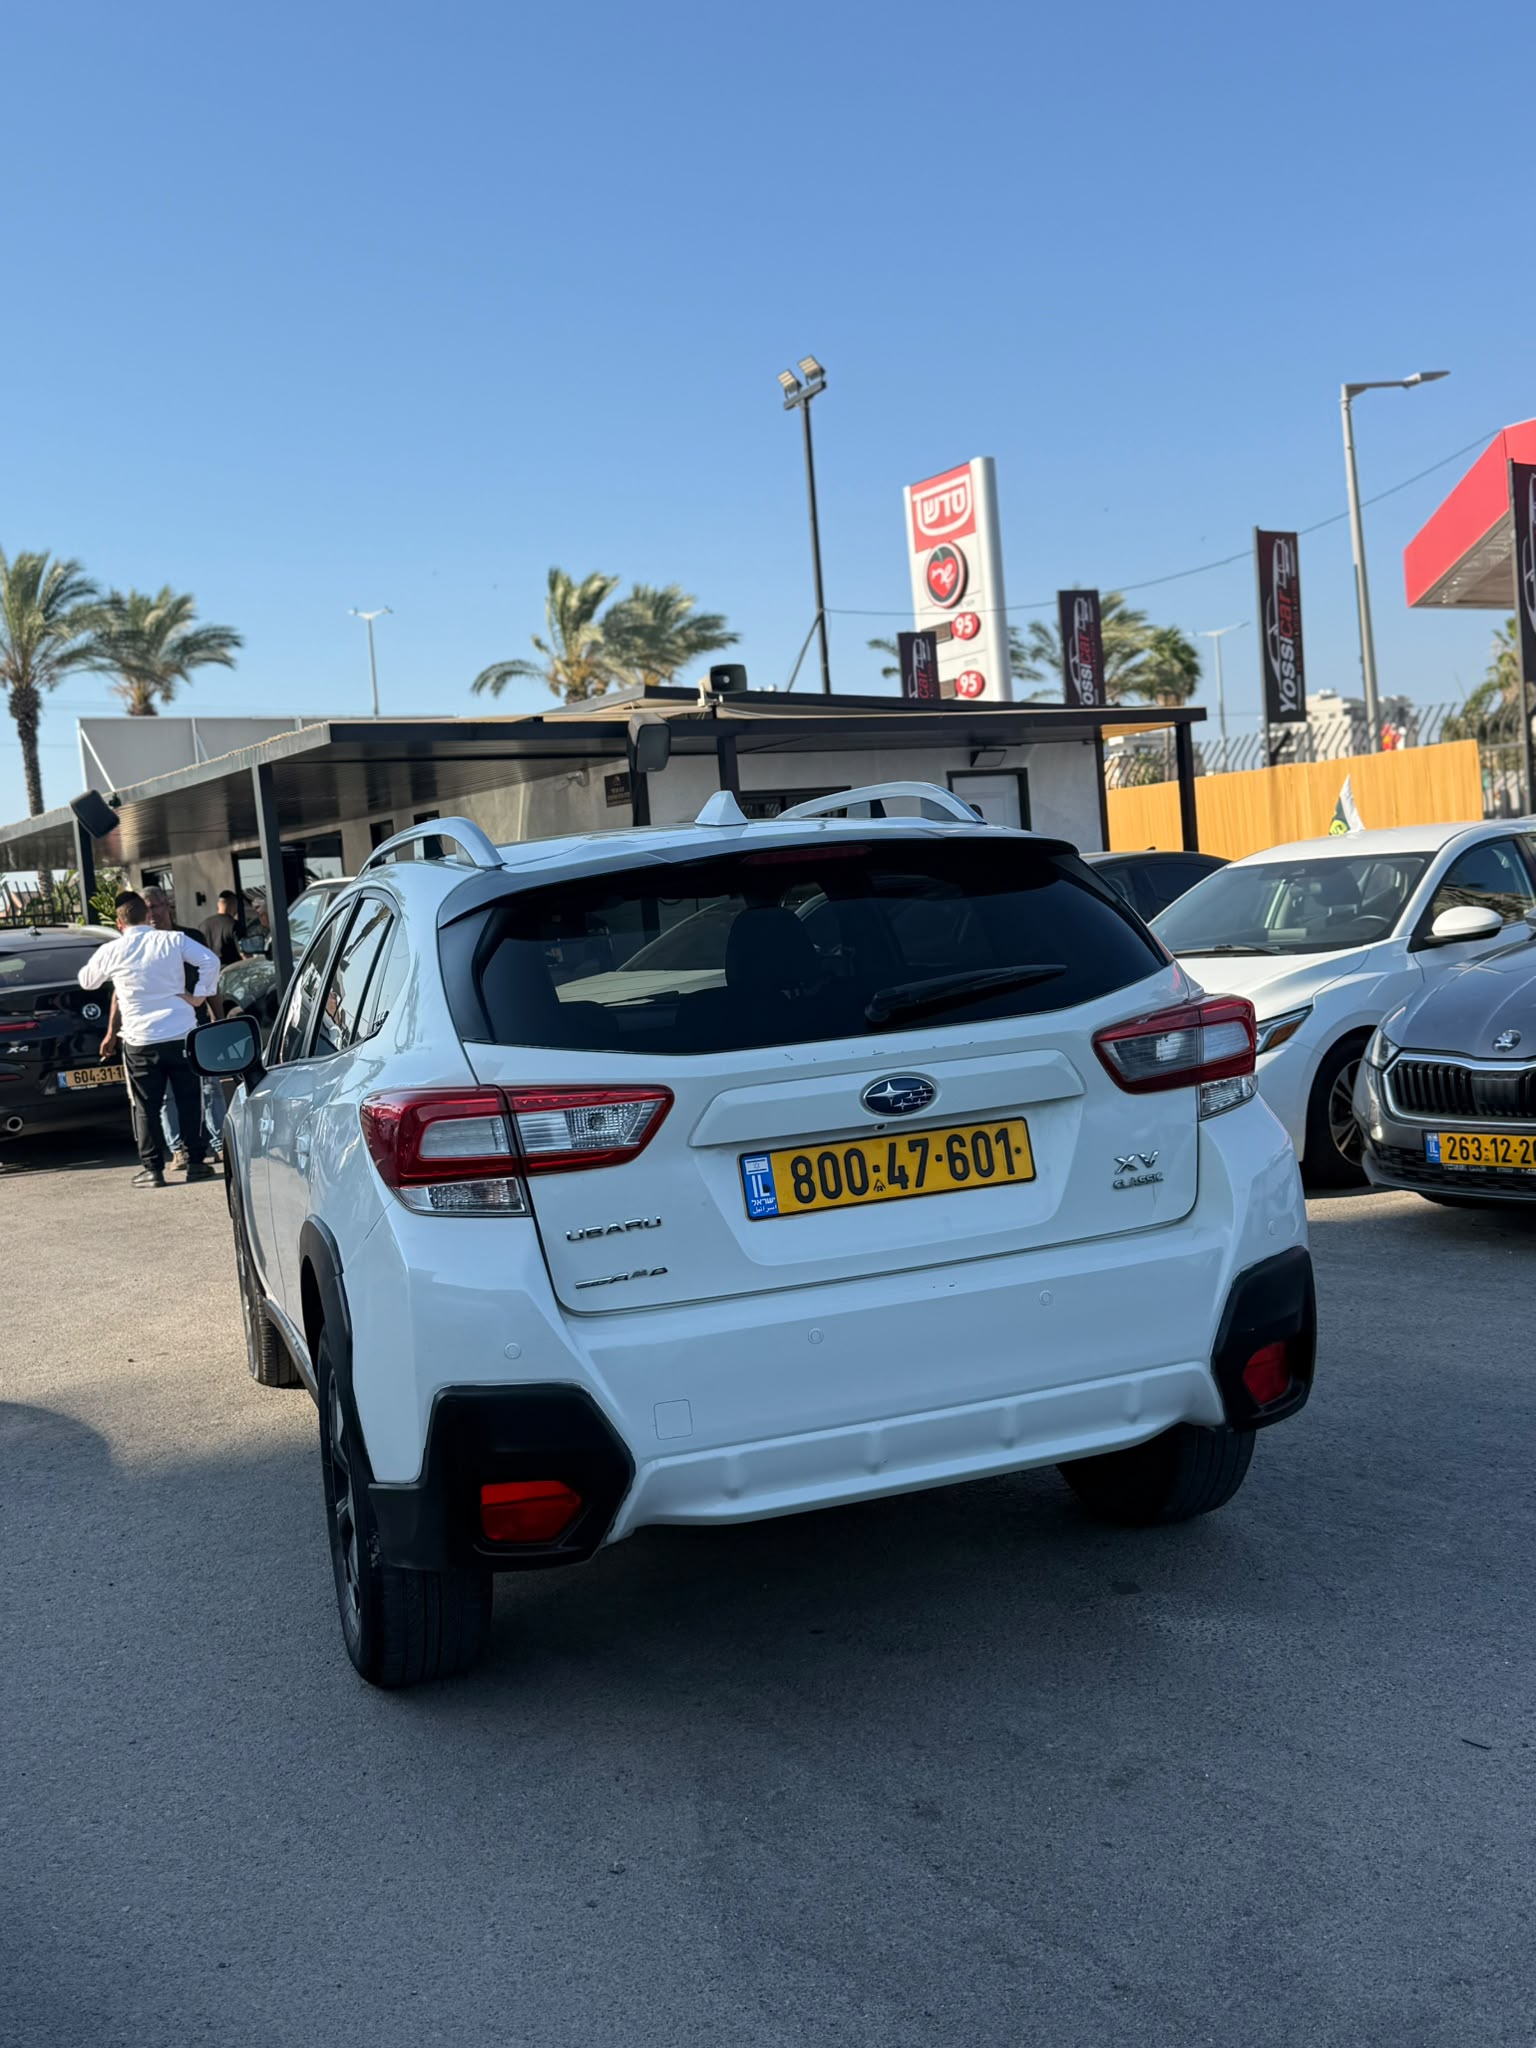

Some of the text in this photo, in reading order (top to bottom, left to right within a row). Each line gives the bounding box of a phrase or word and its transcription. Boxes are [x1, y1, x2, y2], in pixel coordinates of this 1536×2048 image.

[955, 614, 973, 636] 95
[960, 673, 978, 693] 95
[7, 1045, 29, 1054] X4
[1113, 1150, 1160, 1175] XV
[751, 1174, 771, 1198] IL
[751, 1197, 776, 1206] ישראל
[566, 1216, 662, 1241] UBARU
